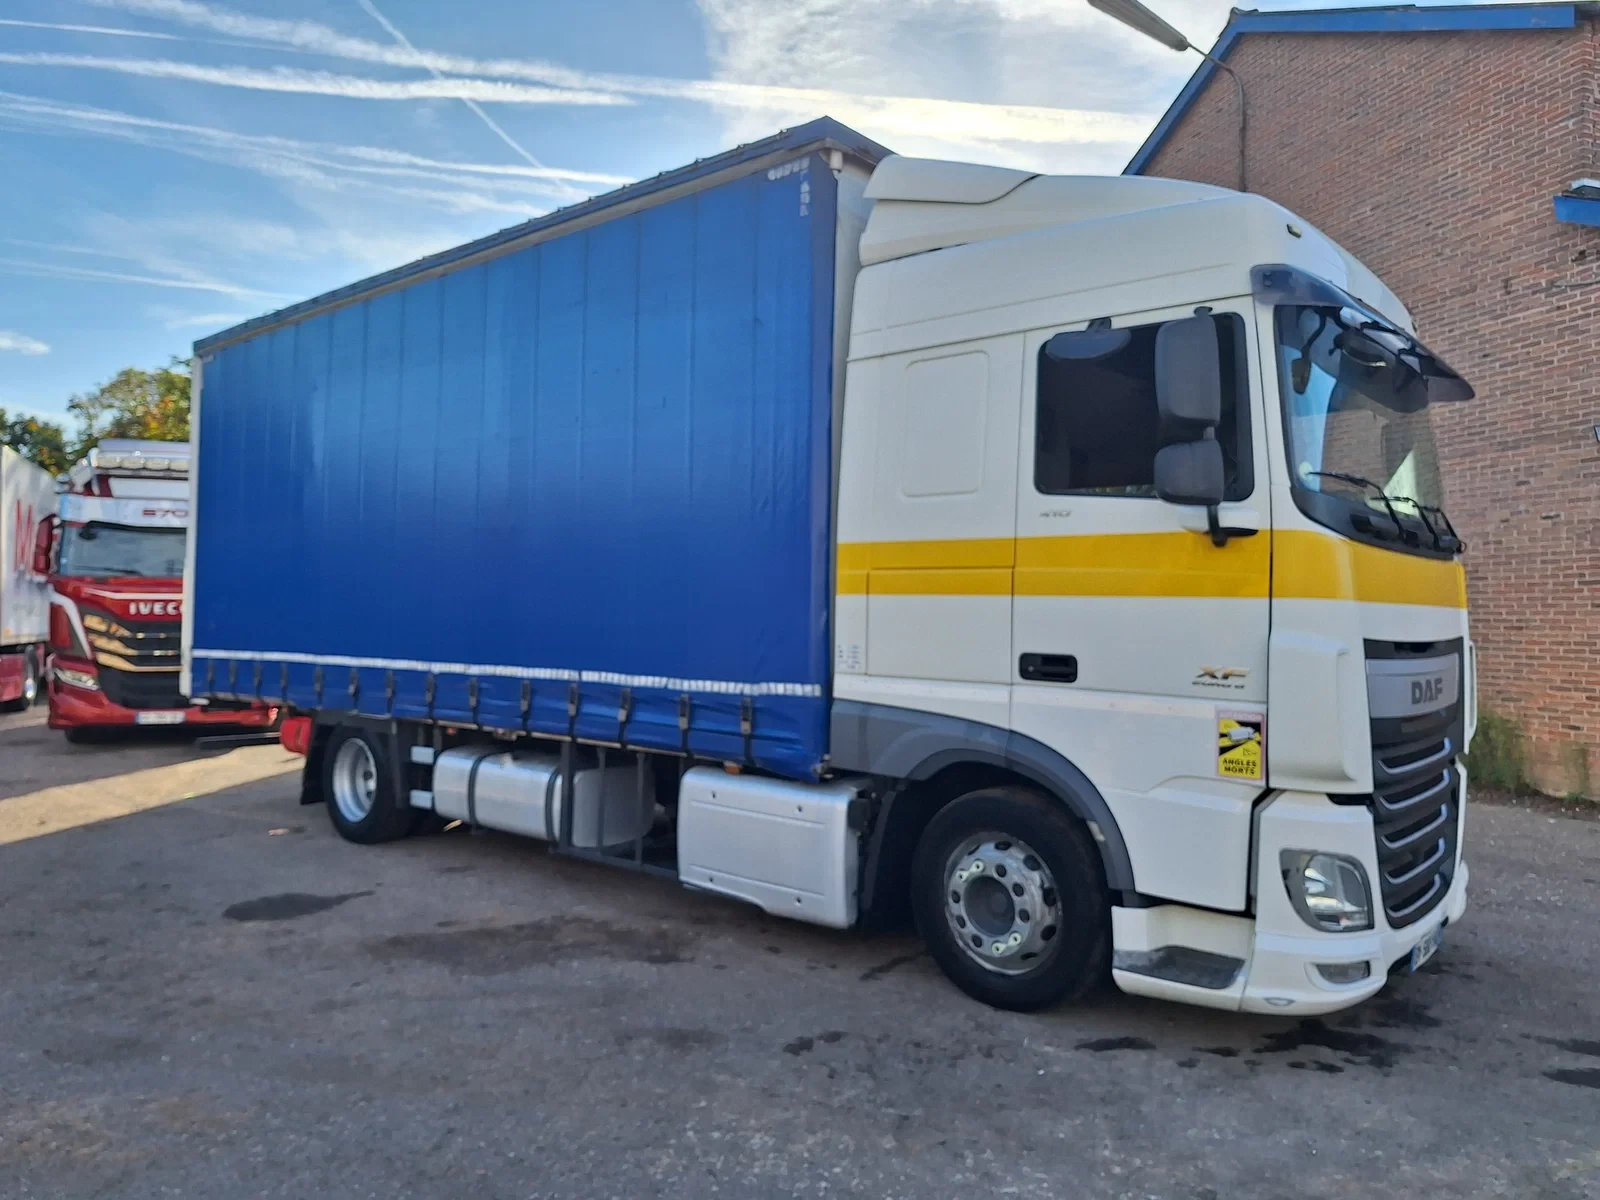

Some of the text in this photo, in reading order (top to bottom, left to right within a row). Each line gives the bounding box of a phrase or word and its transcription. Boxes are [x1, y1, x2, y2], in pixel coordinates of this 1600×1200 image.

[128, 601, 184, 616] IVEC
[1411, 677, 1443, 705] DAF
[1222, 758, 1257, 767] ANGLES
[1223, 766, 1255, 775] MORTS
